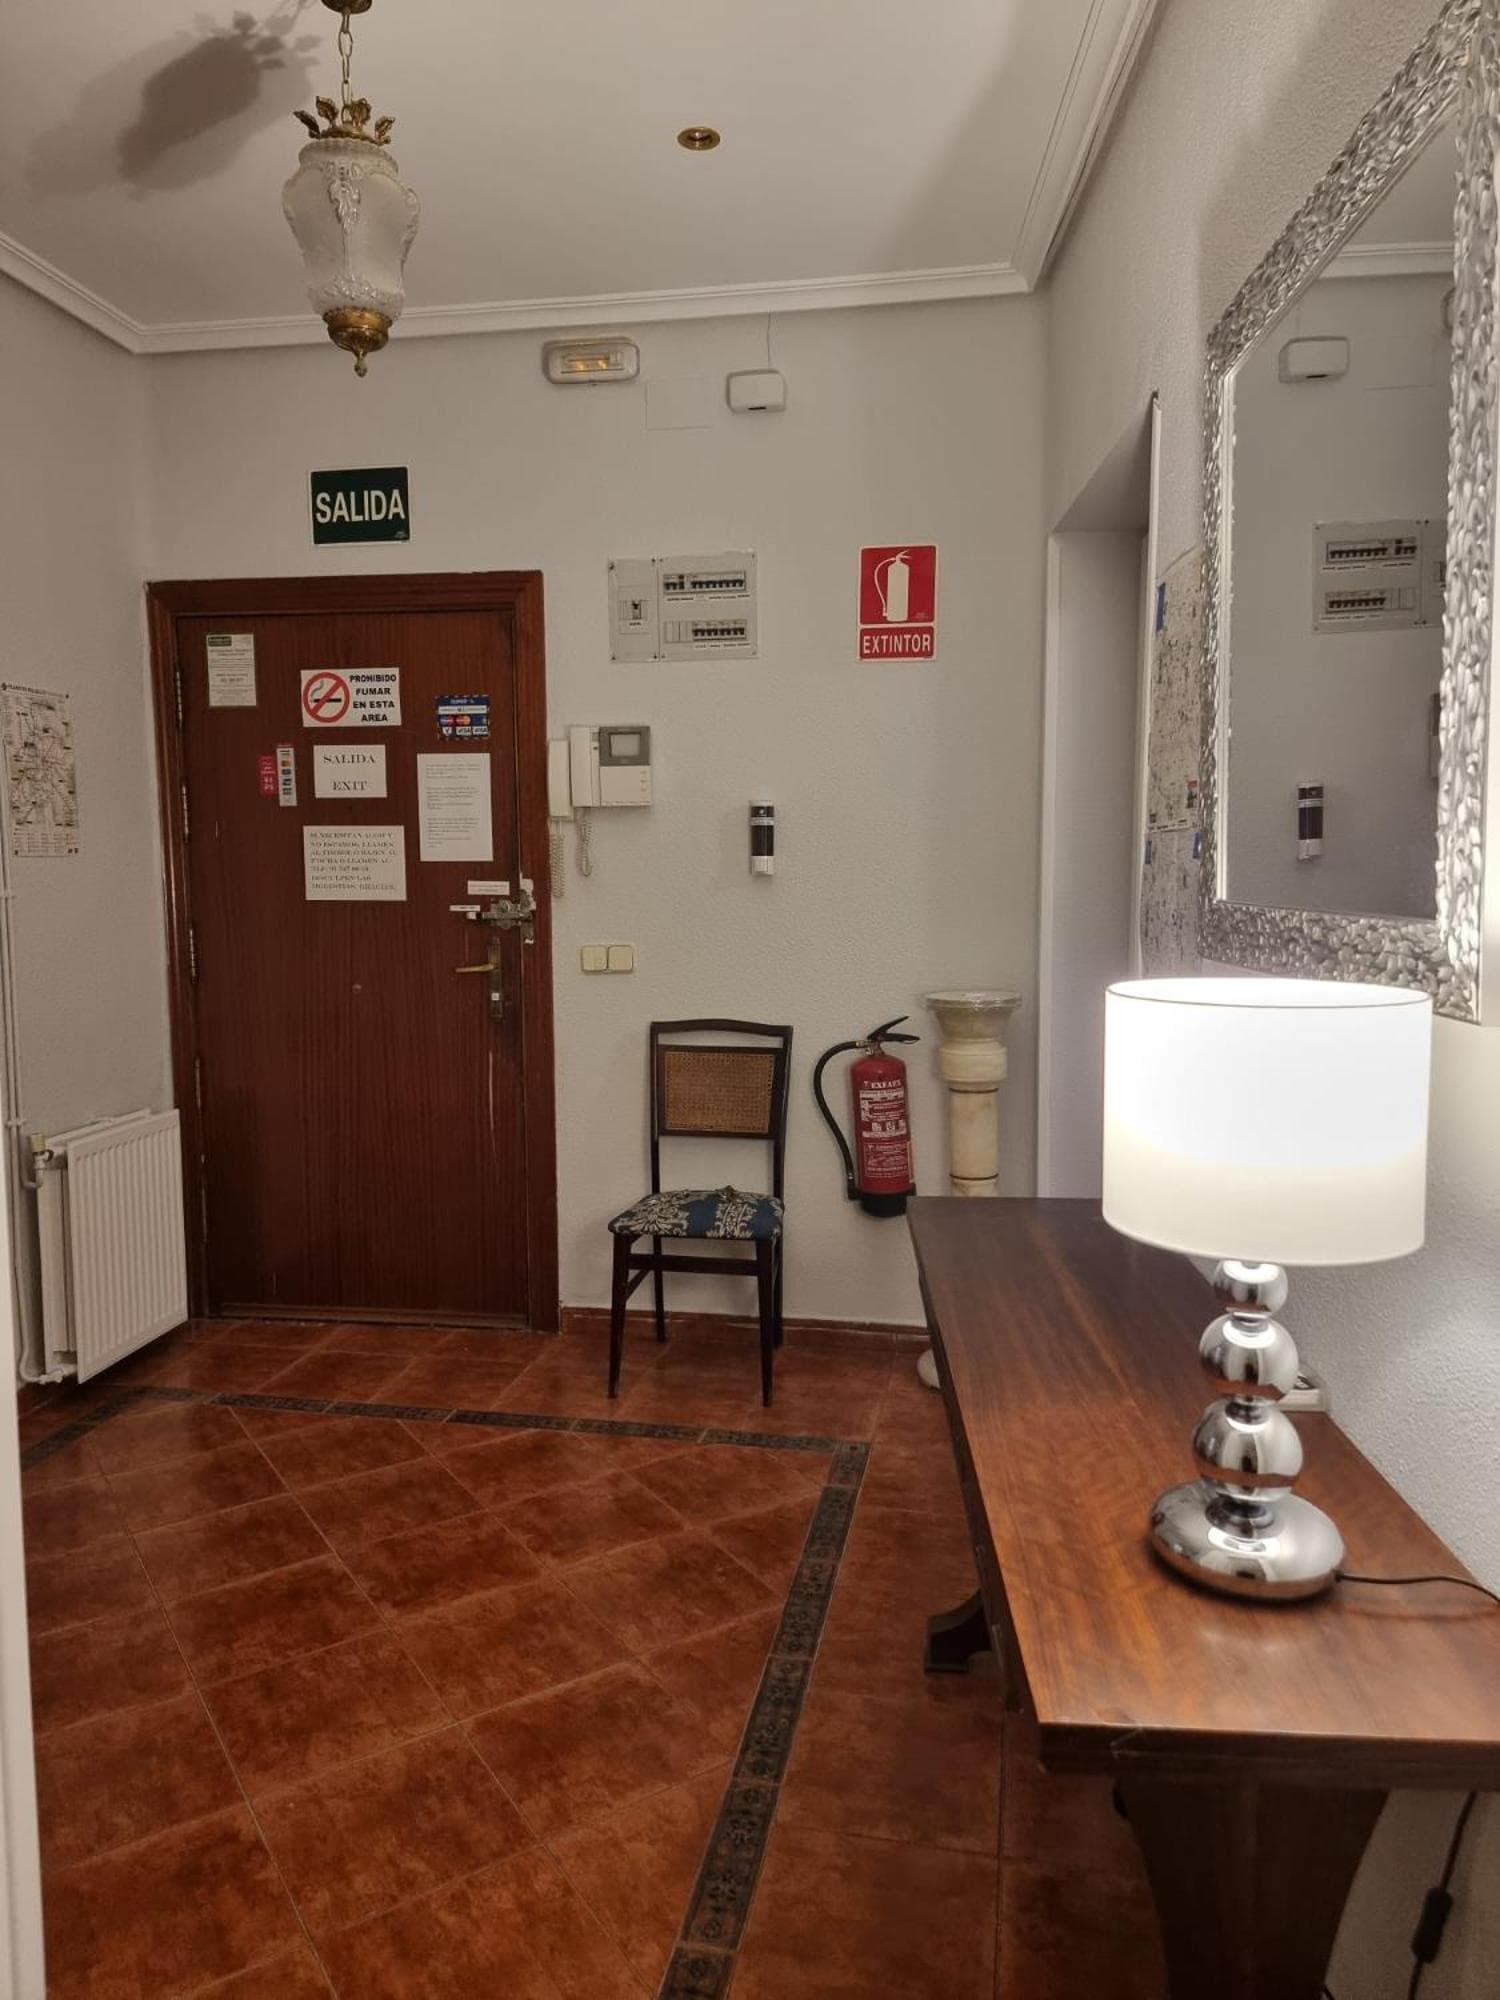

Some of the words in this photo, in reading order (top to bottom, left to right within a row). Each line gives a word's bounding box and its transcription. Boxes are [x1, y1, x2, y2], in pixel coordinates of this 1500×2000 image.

[316, 489, 405, 523] SALIDA
[863, 634, 931, 653] EXTINTOR
[349, 674, 397, 683] PROHIBIDO
[355, 687, 391, 696] FUMAR
[353, 700, 367, 709] EN
[369, 700, 395, 709] ESTA
[361, 714, 388, 722] AREA
[323, 754, 376, 764] SALIDA
[333, 780, 367, 791] EXIT
